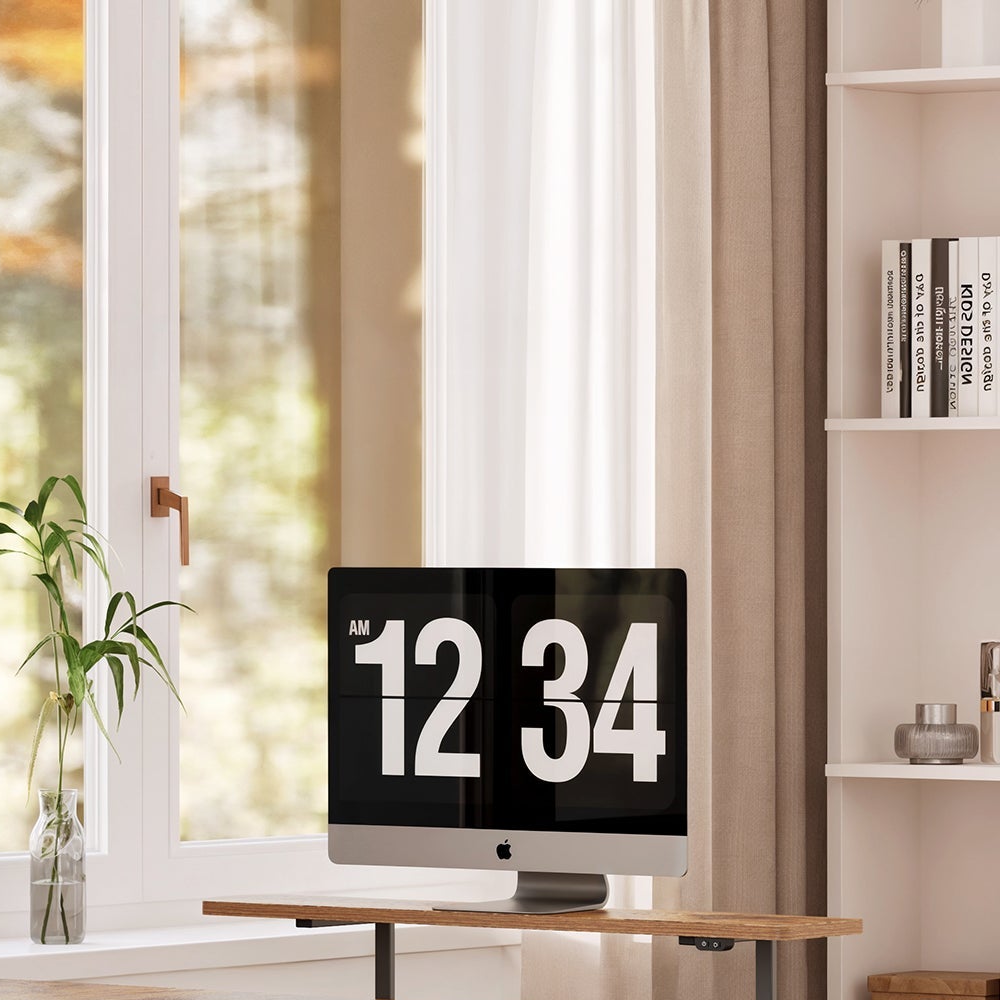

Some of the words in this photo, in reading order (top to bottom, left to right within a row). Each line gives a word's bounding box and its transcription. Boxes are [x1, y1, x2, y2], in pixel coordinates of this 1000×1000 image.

[349, 620, 370, 636] AM
[354, 617, 482, 778] 12
[521, 618, 666, 783] 34
